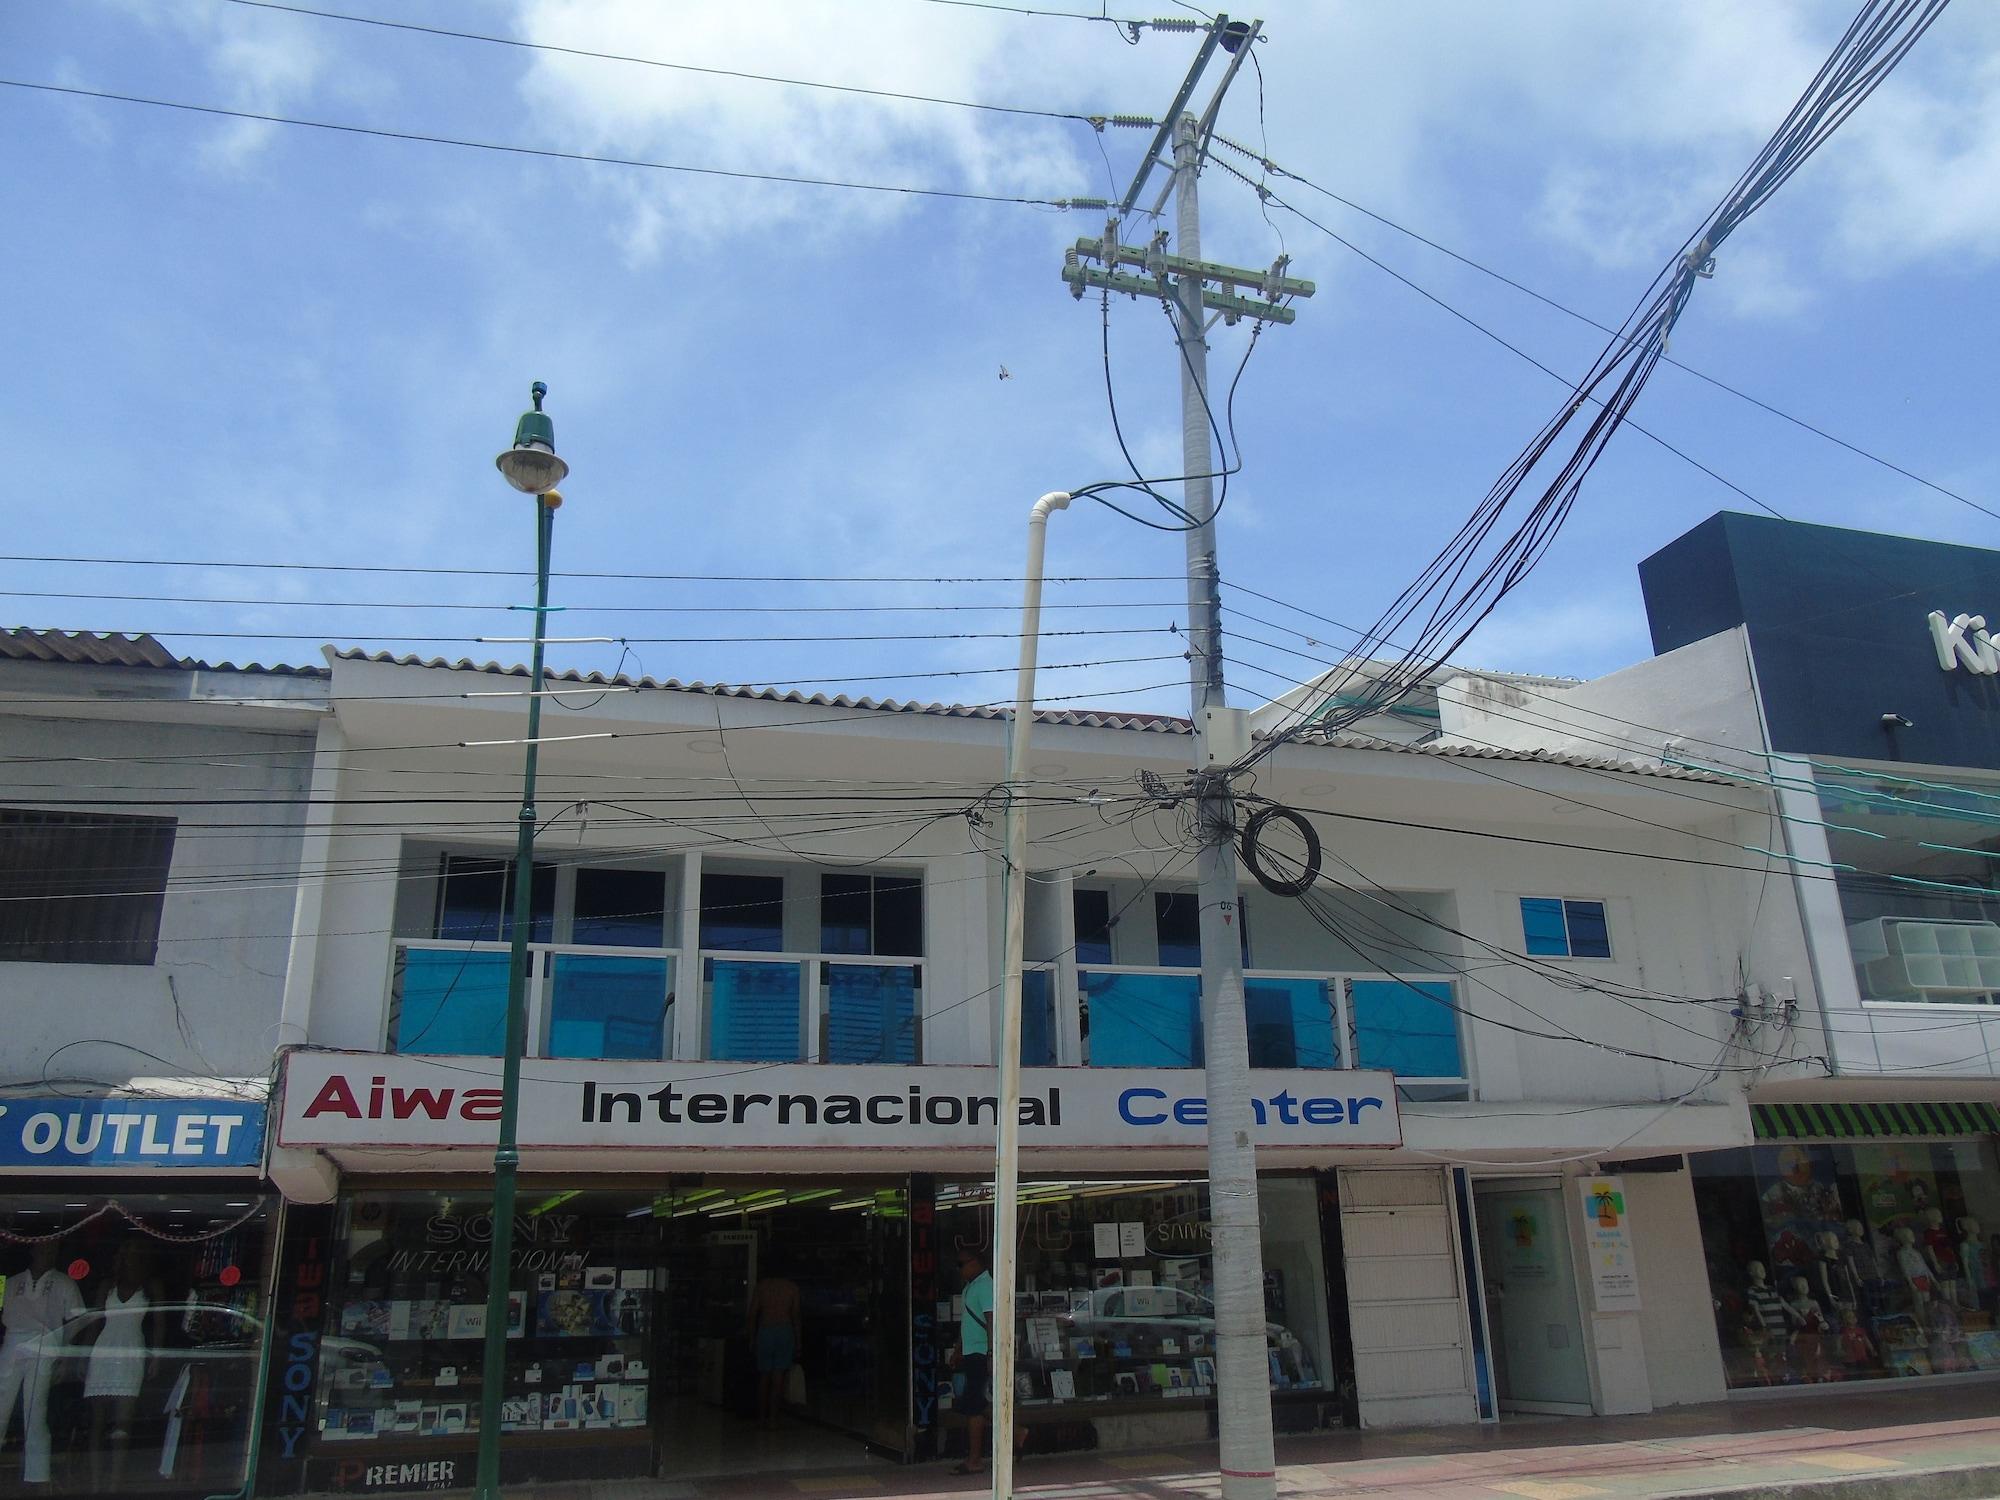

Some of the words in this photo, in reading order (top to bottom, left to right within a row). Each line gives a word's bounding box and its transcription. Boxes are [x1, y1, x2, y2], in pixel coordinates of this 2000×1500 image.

[302, 1075, 503, 1120] Aiwa
[581, 1081, 1061, 1126] Internacional
[20, 1112, 244, 1154] OUTLET
[426, 1214, 580, 1244] SONY
[465, 1316, 482, 1327] Wii
[279, 1329, 319, 1459] SONY
[336, 1456, 456, 1488] PREMIER
